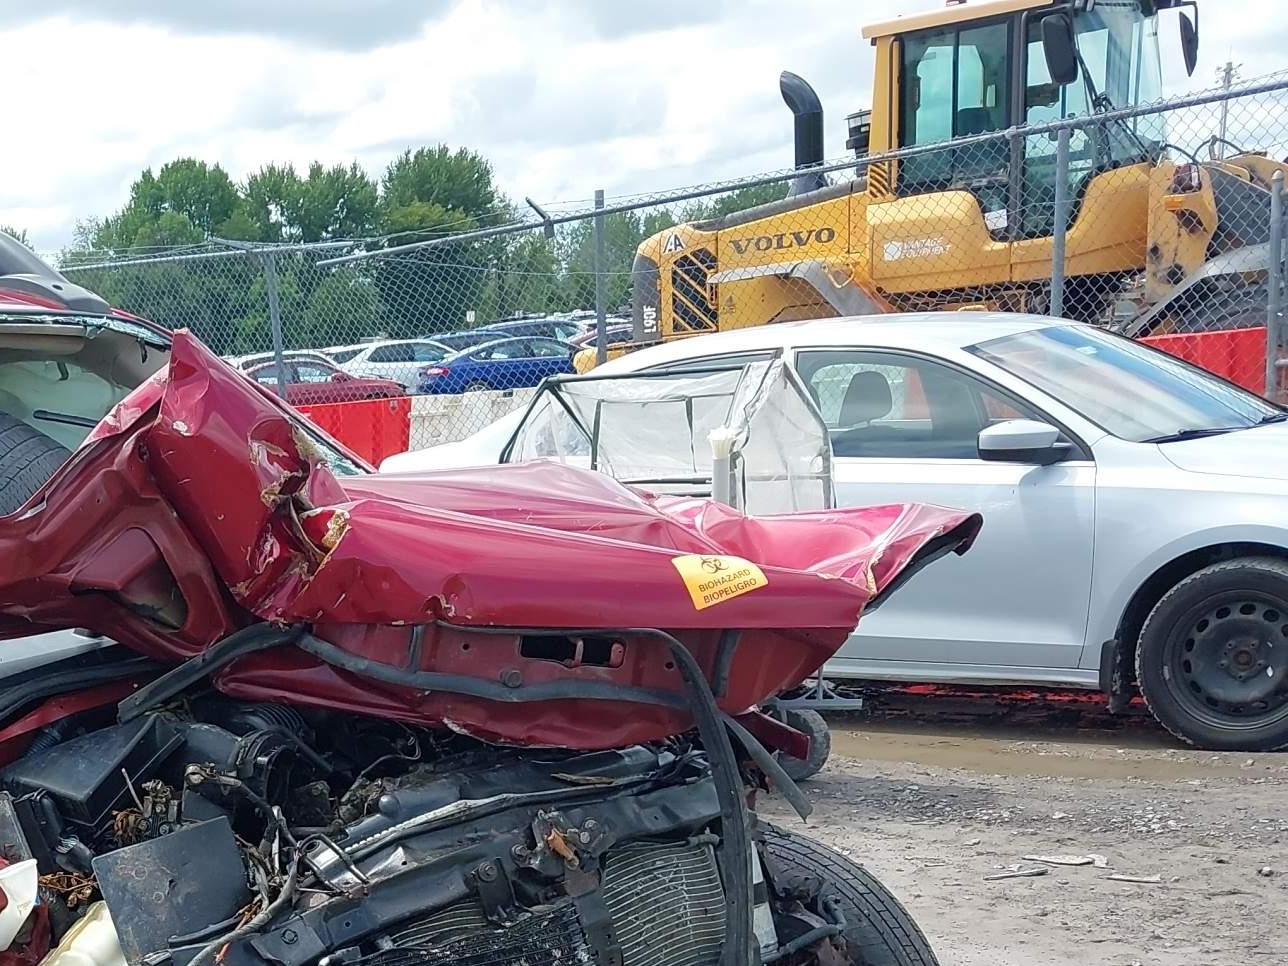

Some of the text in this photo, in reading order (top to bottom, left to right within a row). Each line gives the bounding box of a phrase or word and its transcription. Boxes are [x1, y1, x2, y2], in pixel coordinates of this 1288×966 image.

[729, 227, 835, 254] VOLVO
[643, 305, 657, 334] L90F
[698, 568, 751, 593] BIOHAZARD
[703, 578, 757, 604] BIOPELIGRO
